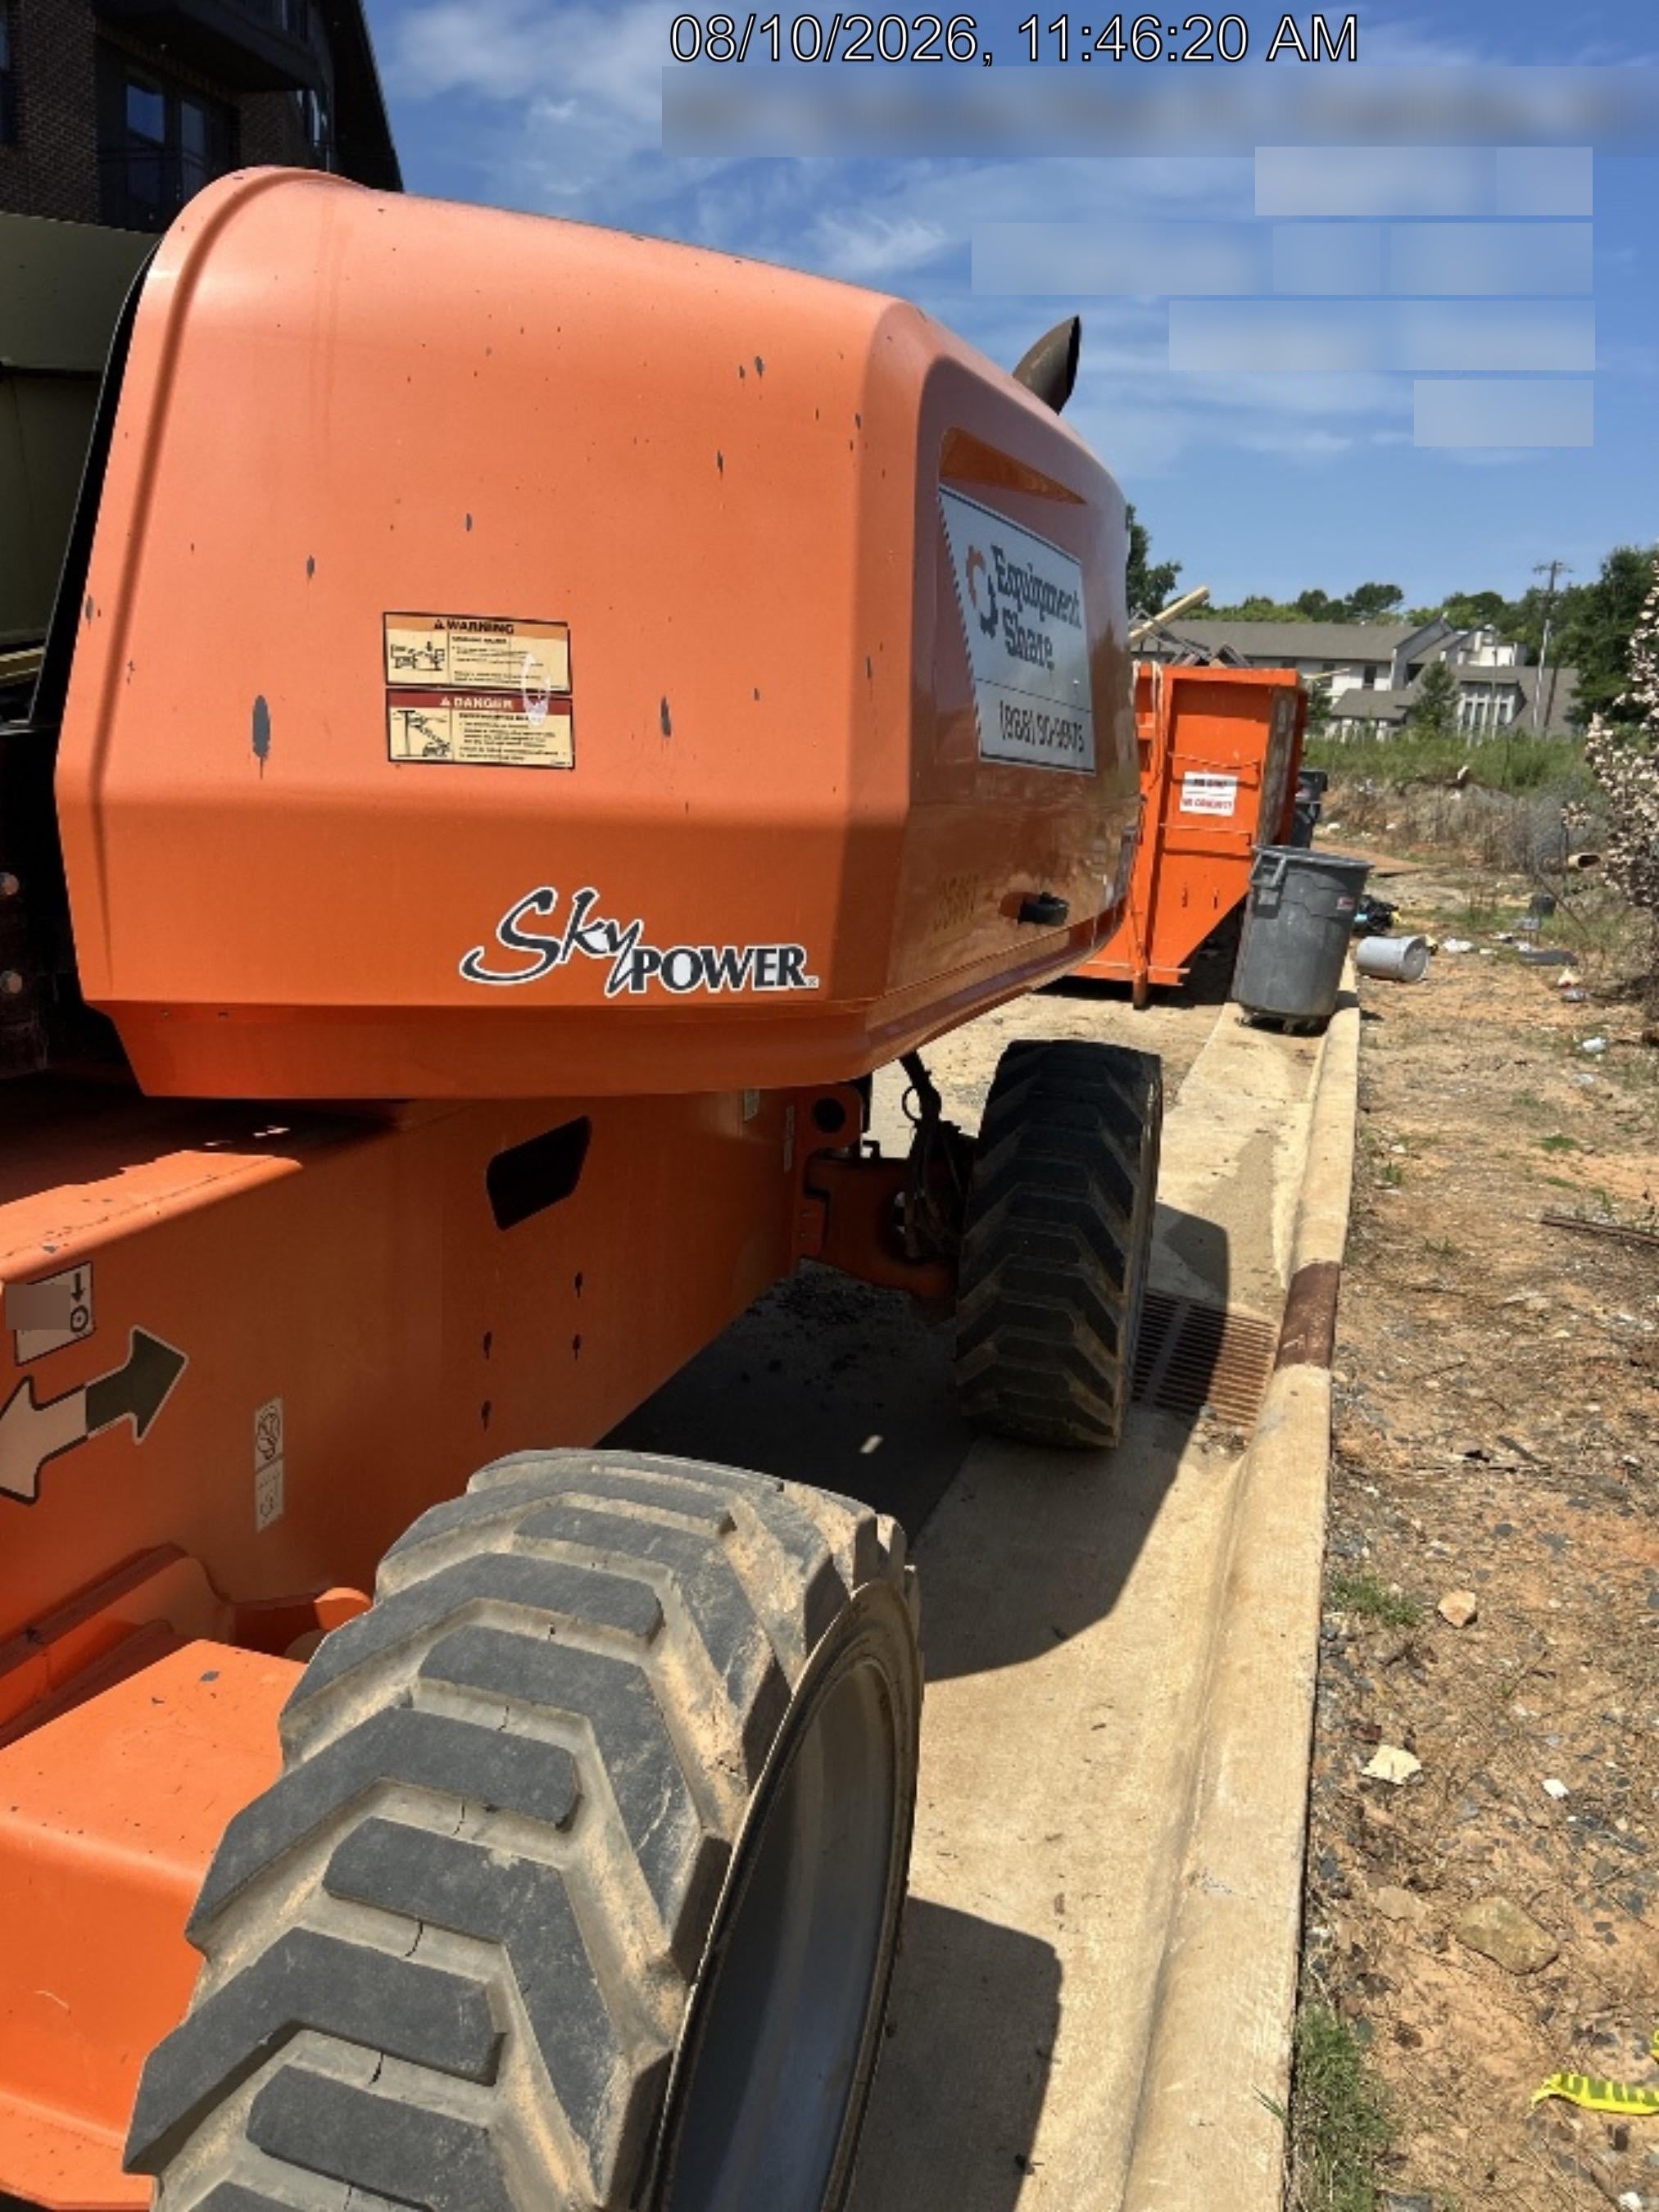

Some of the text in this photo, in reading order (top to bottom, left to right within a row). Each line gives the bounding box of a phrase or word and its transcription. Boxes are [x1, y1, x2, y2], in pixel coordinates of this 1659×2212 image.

[990, 543, 1082, 629] Equipment
[446, 619, 514, 635] WARNING
[1002, 607, 1055, 671] Share
[454, 696, 514, 709] DANGER
[628, 944, 808, 993] POWER
